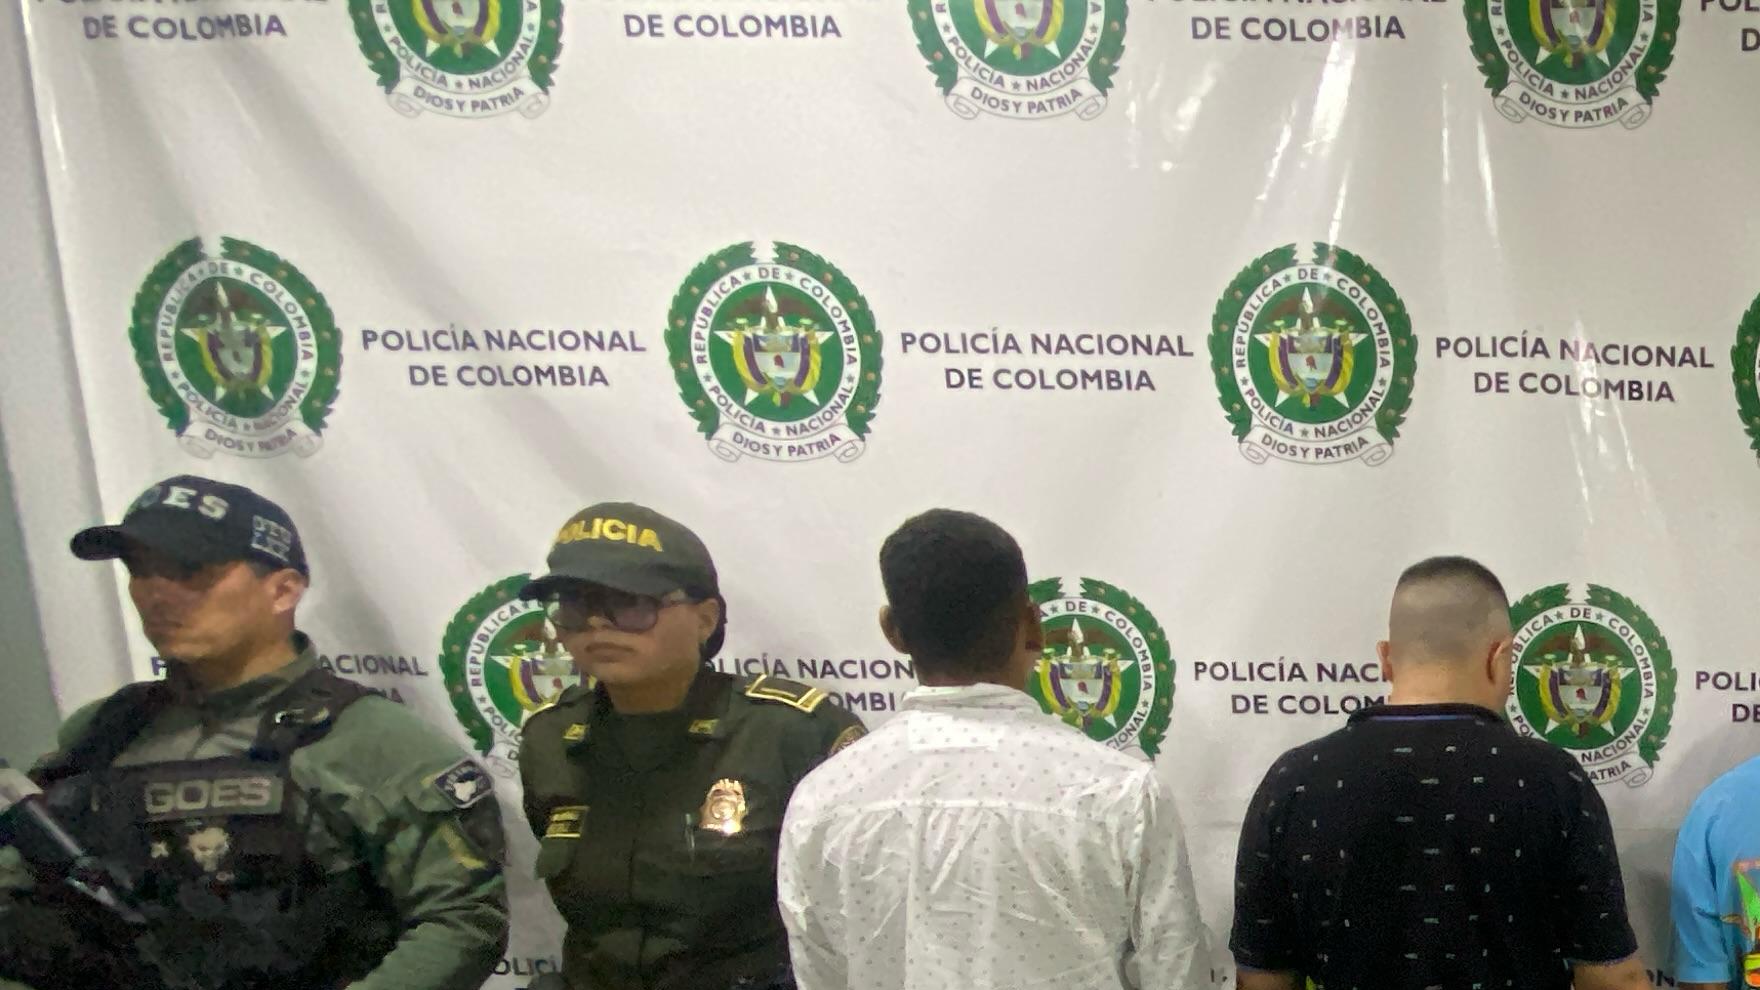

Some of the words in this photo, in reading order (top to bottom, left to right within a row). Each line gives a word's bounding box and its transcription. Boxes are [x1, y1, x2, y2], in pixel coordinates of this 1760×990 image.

[83, 15, 118, 39] DE
[128, 14, 287, 40] COLOMBIA
[624, 14, 665, 38] DE
[674, 14, 842, 38] COLOMBIA
[1191, 17, 1231, 40] DE
[1241, 15, 1406, 41] COLOMBIA
[1026, 37, 1097, 91] NACIONAL
[1575, 45, 1647, 100] NACIONAL
[971, 87, 1009, 111] DIOS
[1028, 89, 1082, 114] PATRIA
[1519, 92, 1557, 120] DIOS
[1574, 97, 1628, 122] PATRIA
[758, 267, 780, 279] DE
[800, 277, 858, 366] COLOMBIA
[1297, 268, 1318, 280] DE
[1337, 278, 1390, 369] COLOMBIA
[361, 323, 480, 351] POLICÍA
[483, 329, 647, 351] NACIONAL
[900, 327, 1022, 354] POLICÍA
[1030, 333, 1194, 357] NACIONAL
[1435, 330, 1551, 359] POLICÍA
[1559, 338, 1714, 368] NACIONAL
[408, 365, 448, 386] DE
[456, 365, 609, 387] COLOMBIA
[945, 368, 984, 389] DE
[992, 368, 1156, 391] COLOMBIA
[1474, 372, 1510, 393] DE
[1518, 372, 1675, 402] COLOMBIA
[786, 386, 853, 436] NACIONAL
[1315, 389, 1384, 438] NACIONAL
[733, 431, 770, 456] DIOS
[788, 433, 841, 457] PATRIA
[1261, 434, 1298, 457] DIOS
[1315, 436, 1369, 459] PATRIA
[1065, 601, 1087, 612] DE
[1105, 610, 1152, 691] COLOMBIA
[1570, 607, 1591, 619] DE
[1609, 617, 1654, 699] COLOMBIA
[319, 654, 428, 677] ACIONAL
[797, 659, 915, 680] NACION
[1194, 656, 1309, 682] POLICÍA
[1231, 694, 1268, 714] DE
[1581, 718, 1648, 763] NACIONAL
[1587, 760, 1632, 781] ATRIA
[144, 777, 271, 814] GOES
